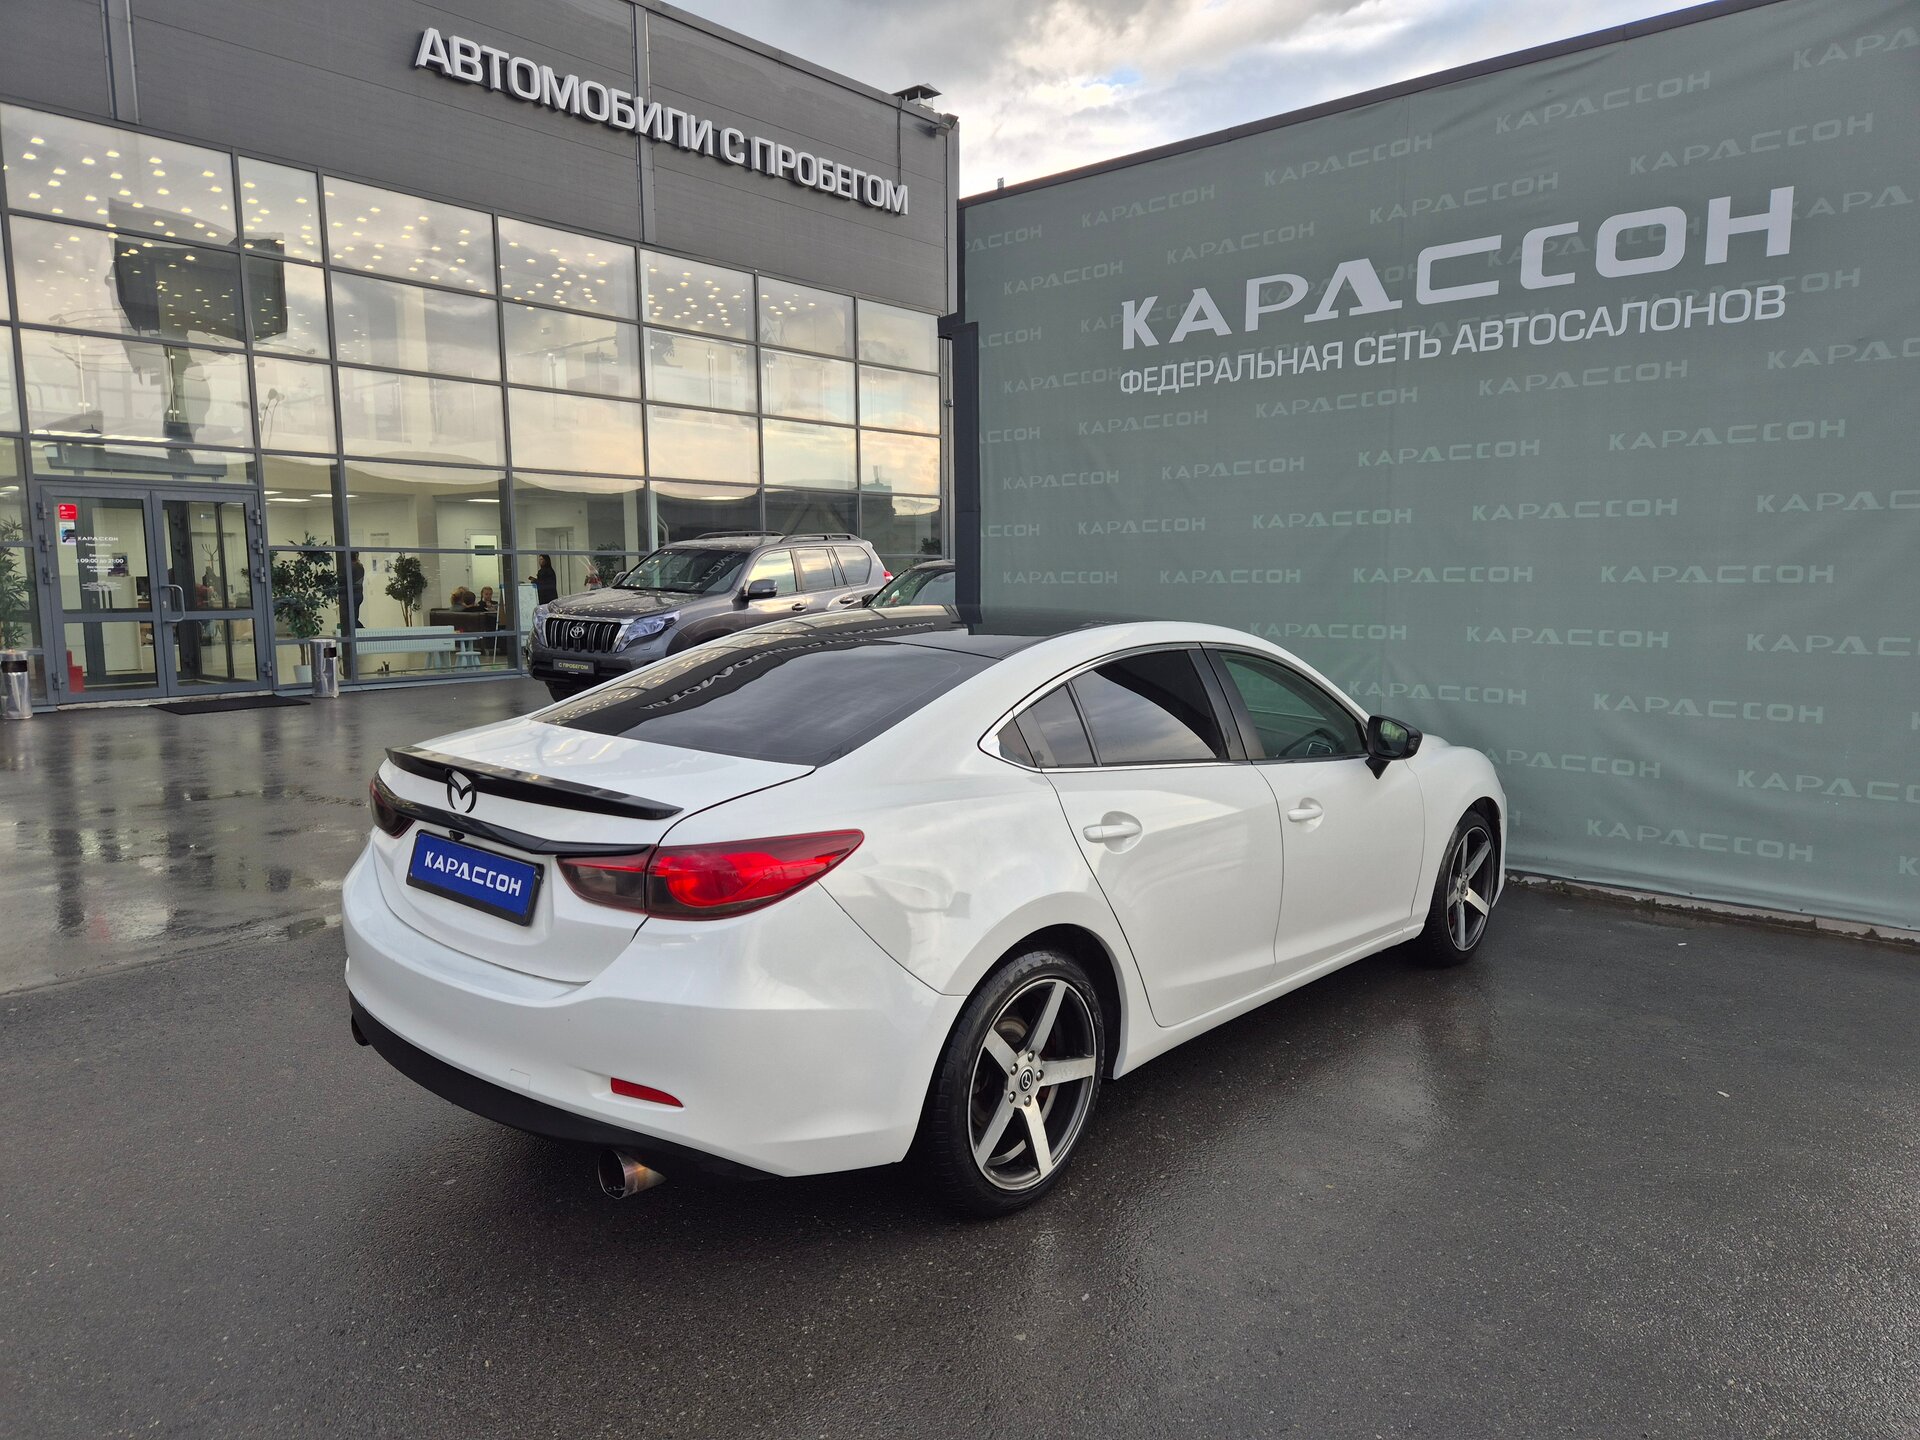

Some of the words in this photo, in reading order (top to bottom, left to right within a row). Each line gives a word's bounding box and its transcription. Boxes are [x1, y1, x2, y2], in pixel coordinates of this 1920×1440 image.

[1496, 70, 1712, 135] КАРАССОН
[415, 27, 714, 157] АВТОМОБИЛИ
[720, 127, 746, 166] С
[751, 136, 909, 216] ПРОБЕГОМ
[1264, 132, 1434, 187] КАРАССОН
[1630, 112, 1874, 176] КАРАССОН
[1081, 184, 1216, 229] КАРАССОН
[1370, 172, 1560, 226] КАРАССОН
[1167, 221, 1315, 266] КАРАССОН
[1004, 260, 1123, 296] КАРАССОН
[1122, 186, 1795, 351] КАРАССОН
[1120, 342, 1343, 394] ФЕДЕРАЛЬНАЯ
[1354, 329, 1442, 367] СЕТЬ
[1452, 284, 1787, 355] АВТОСАЛОНОВ
[1479, 359, 1689, 396] КАРАССОН
[1256, 387, 1418, 419] КАРАССОН
[1079, 409, 1208, 436] КАРАССОН
[1609, 418, 1846, 452] КАРАССОН
[1162, 456, 1305, 480] КАРАССОН
[1358, 439, 1540, 468] КАРАССОН
[1003, 469, 1120, 491] КАРАССОН
[1253, 508, 1412, 530] КАРАССОН
[1473, 498, 1678, 521] КАРАССОН
[1078, 517, 1206, 536] КАРАССОН
[1003, 570, 1118, 585] КАРАССОН
[1160, 568, 1300, 584] КАРАССОН
[1353, 566, 1533, 584] КАРАССОН
[1600, 564, 1834, 584] КАРАССОН
[1466, 625, 1669, 649] КАРАССОН
[1747, 633, 1920, 657] КАРАС
[1593, 693, 1824, 724] КАРАССОН
[1487, 748, 1661, 779] АРАССОН
[1587, 818, 1814, 863] КАРАССОН
[424, 850, 523, 897] КАРАССОН
